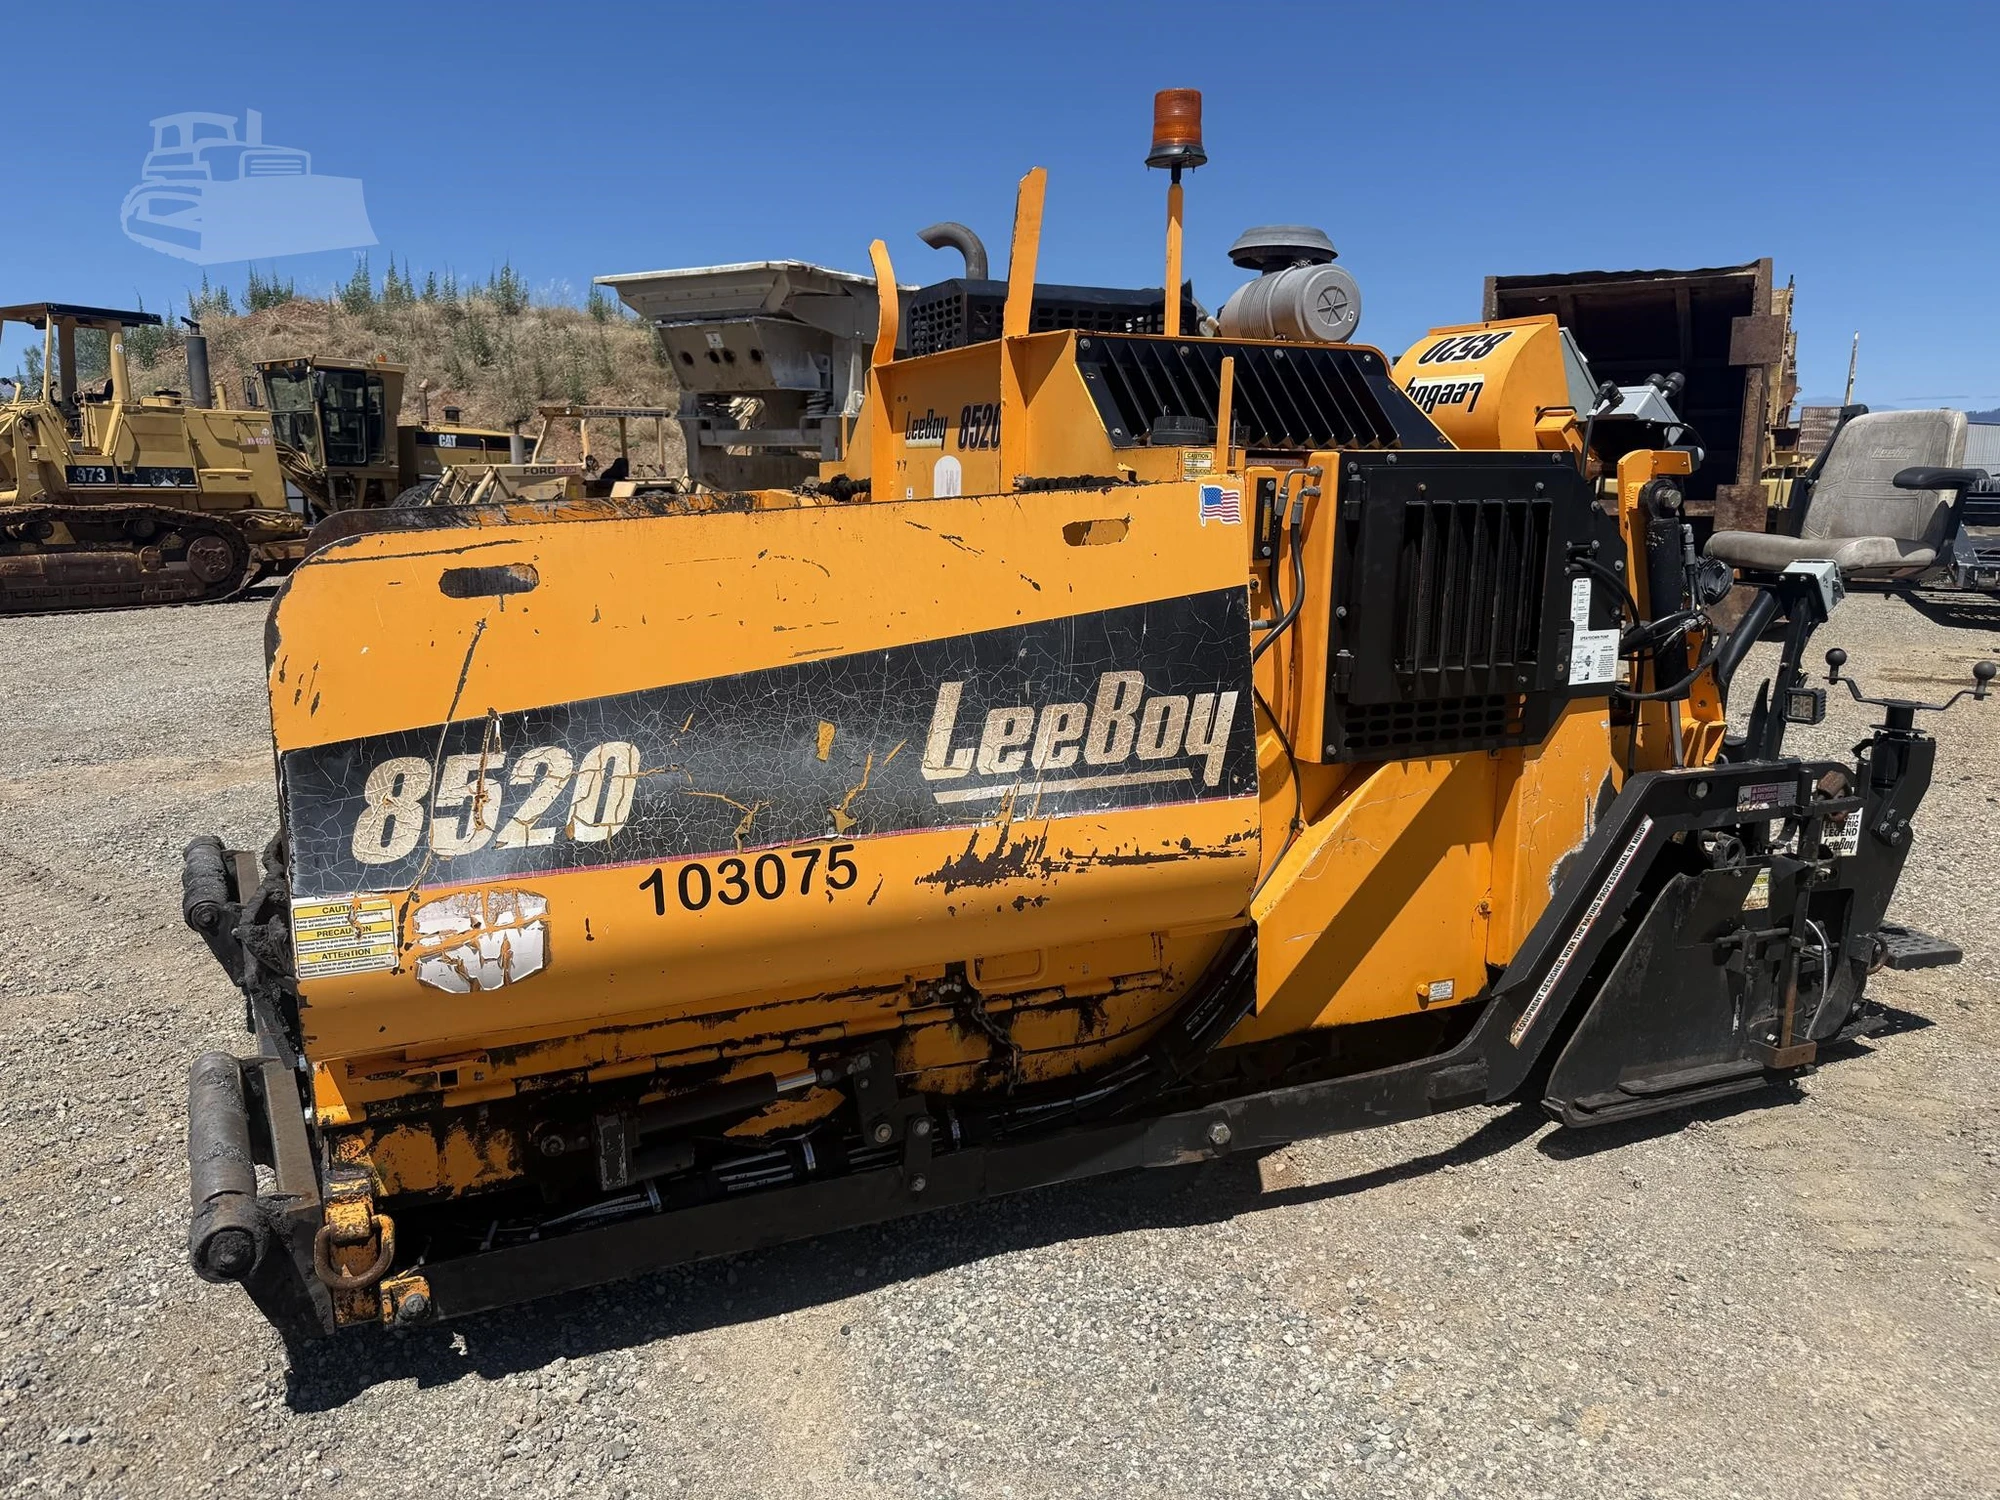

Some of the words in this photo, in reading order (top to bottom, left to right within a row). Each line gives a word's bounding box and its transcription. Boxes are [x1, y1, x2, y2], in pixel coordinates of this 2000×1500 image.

[1417, 331, 1513, 365] 8520
[438, 434, 457, 447] CAT
[905, 408, 948, 451] LeeBoy
[76, 467, 106, 482] 973
[523, 467, 556, 475] FORD
[921, 670, 1239, 787] LeeBoy
[352, 741, 641, 864] 8520
[1824, 828, 1858, 837] LEGEND
[639, 844, 858, 916] 103075
[1563, 939, 1577, 959] WITH
[1573, 925, 1586, 940] THE
[1583, 901, 1601, 926] PAVING
[1597, 852, 1631, 902] PROFESSIONAL
[1627, 843, 1636, 853] IN
[321, 948, 371, 960] ATTENTION
